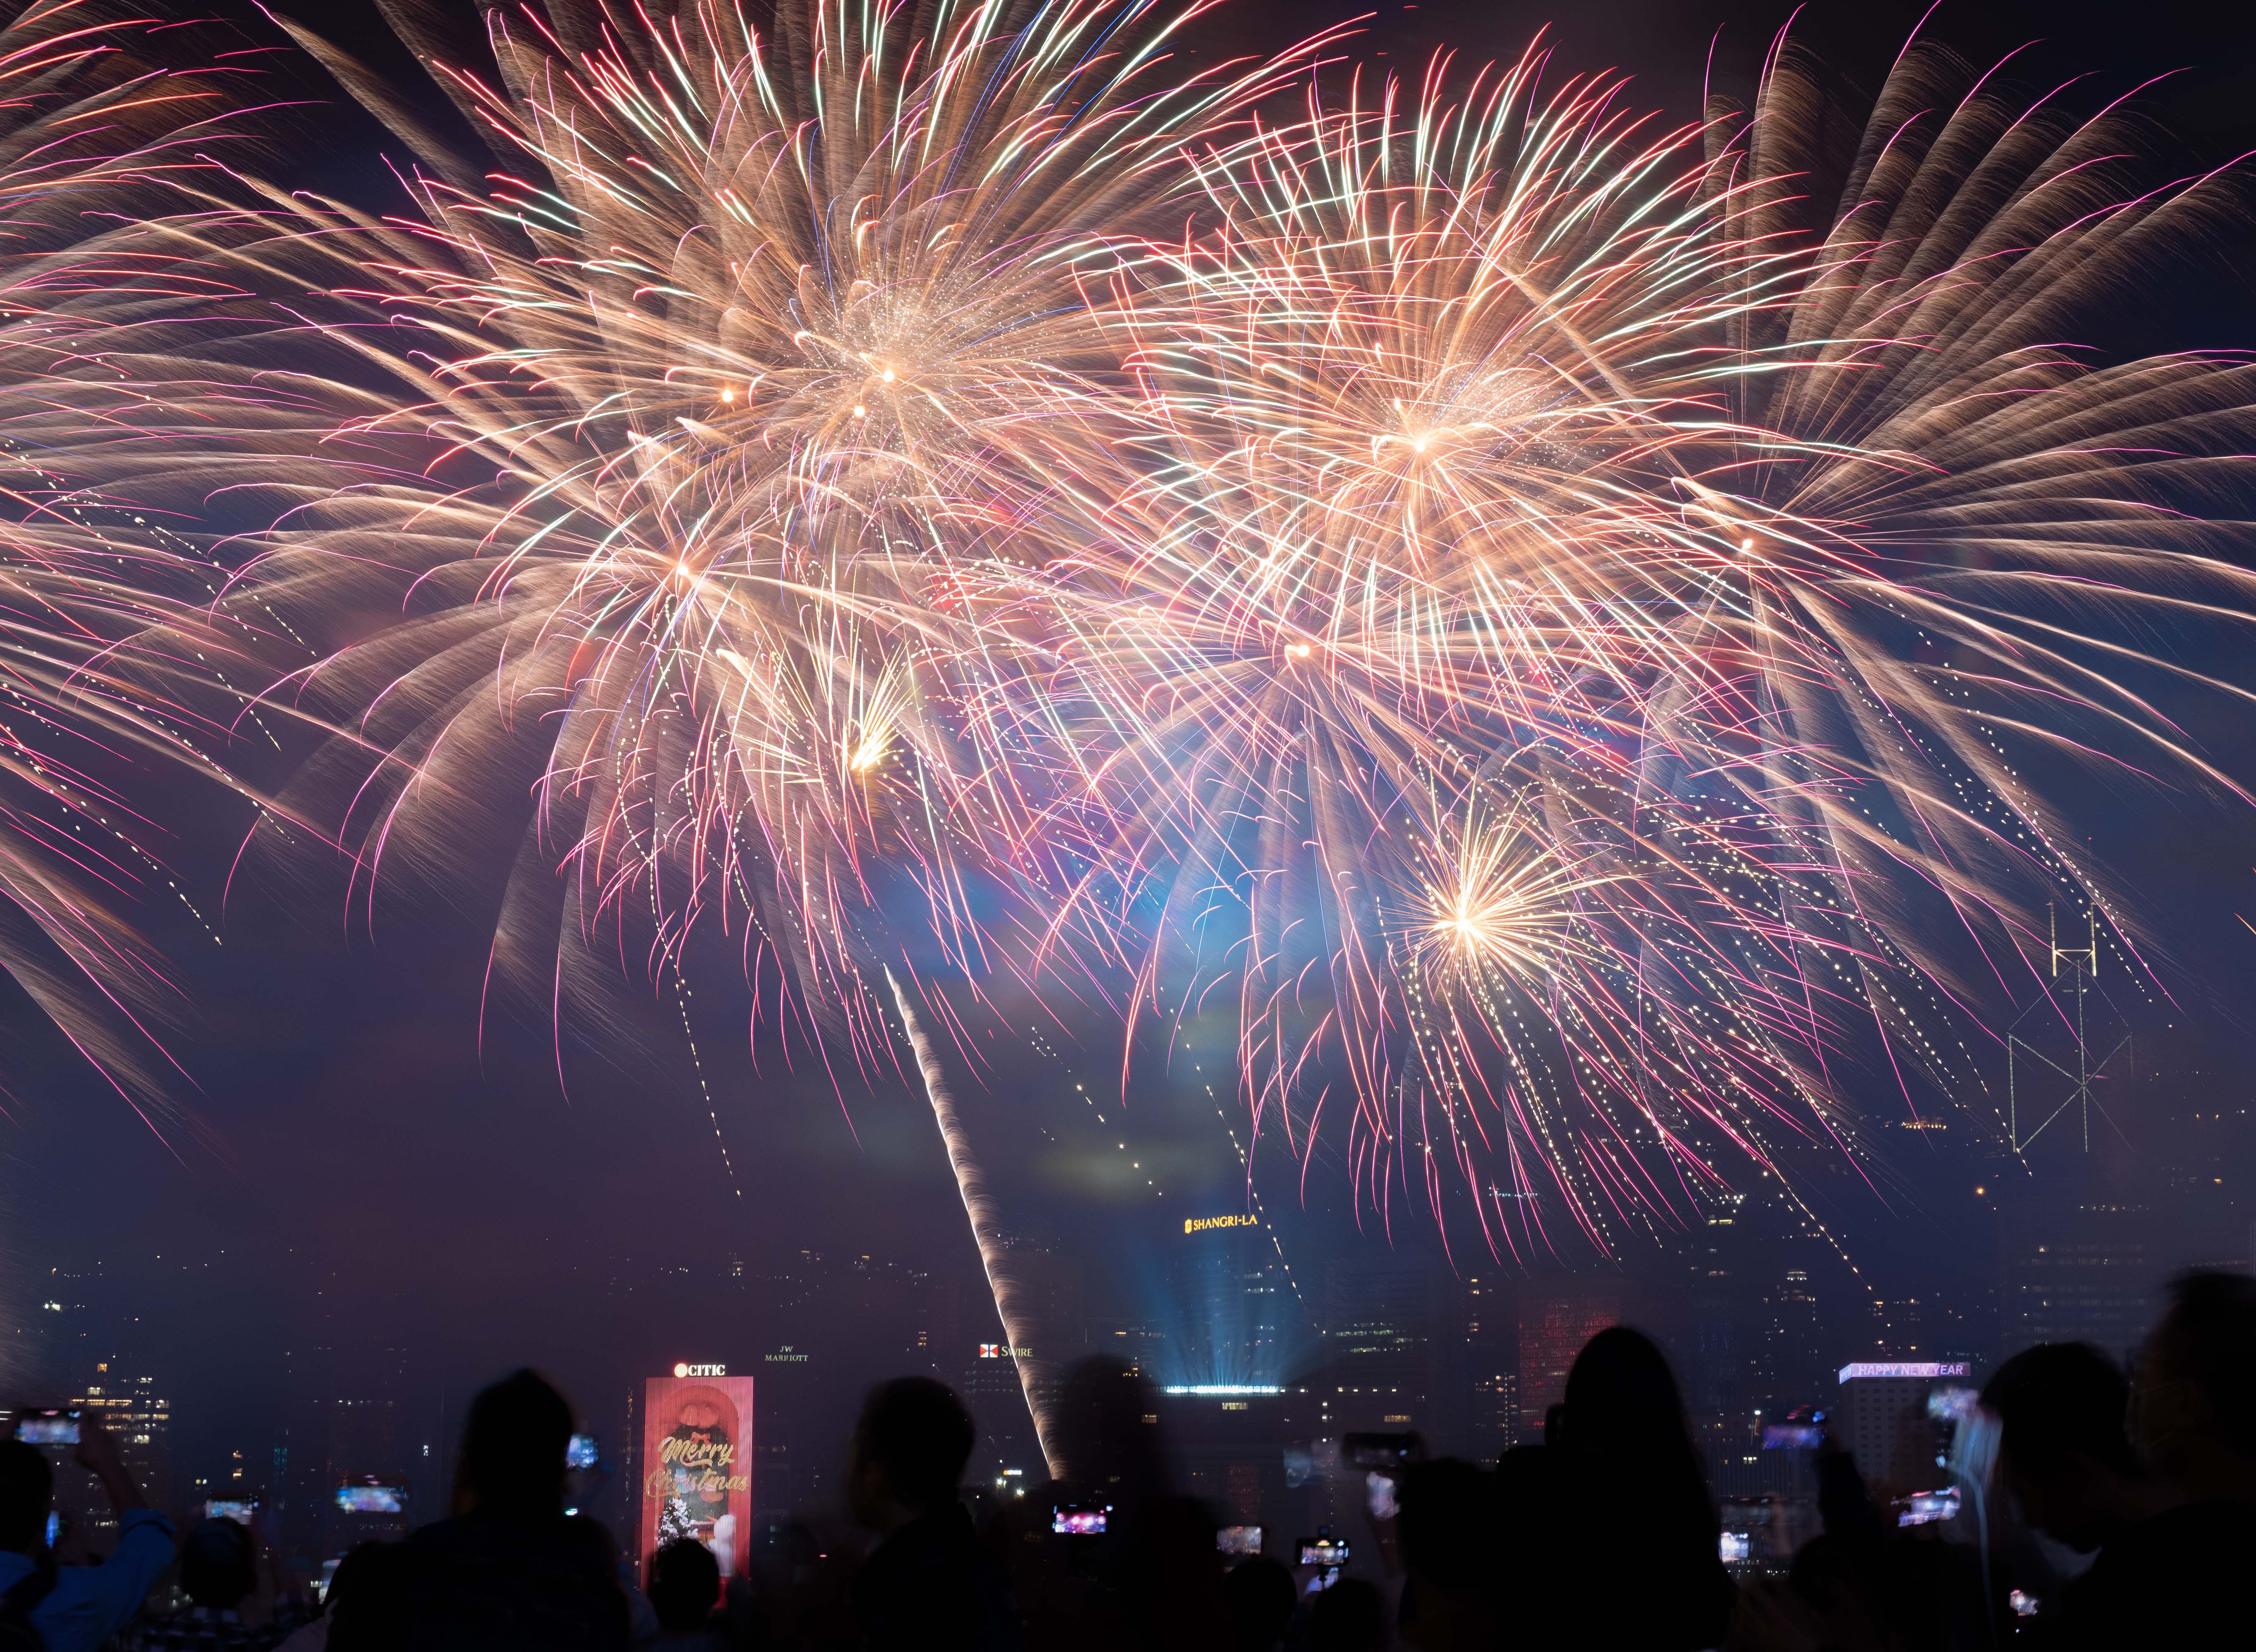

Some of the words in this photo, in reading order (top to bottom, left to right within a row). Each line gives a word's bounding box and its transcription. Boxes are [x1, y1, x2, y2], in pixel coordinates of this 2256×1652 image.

[1193, 1214, 1257, 1230] SHANGRI-LA
[688, 1365, 725, 1376] CITIC
[1858, 1365, 1898, 1376] HAPPY
[1900, 1365, 1929, 1376] NEW
[1933, 1365, 1964, 1375] YEAR
[658, 1436, 735, 1467] Merry
